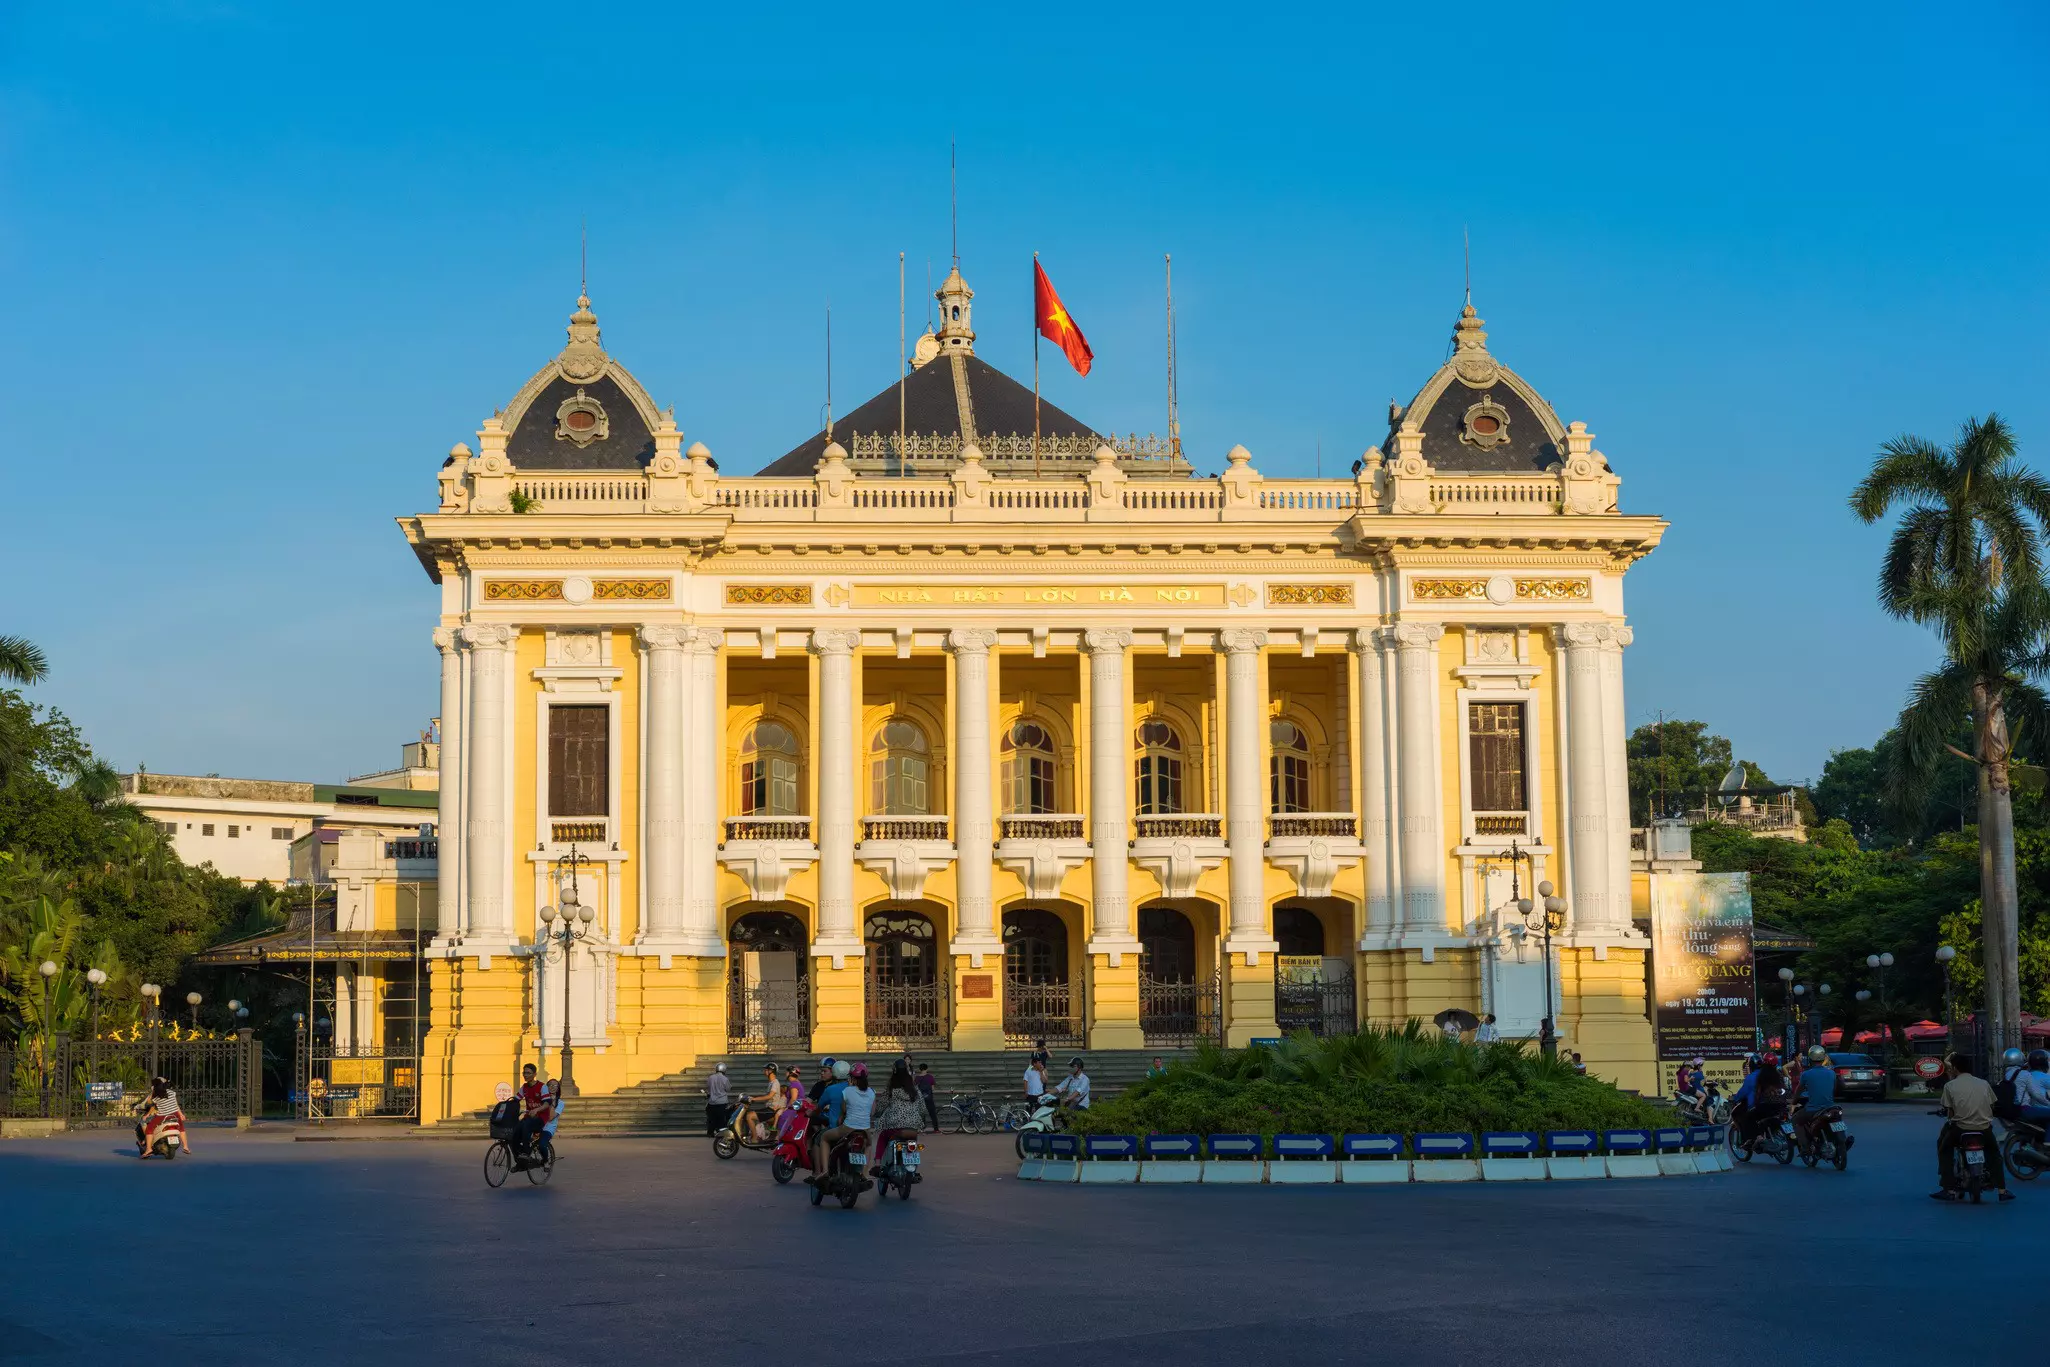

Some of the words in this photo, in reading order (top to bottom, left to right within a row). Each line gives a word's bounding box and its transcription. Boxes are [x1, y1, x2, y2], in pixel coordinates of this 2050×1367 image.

[879, 585, 933, 603] NHÀ
[1098, 585, 1134, 602] HÀ
[1156, 586, 1201, 605] NỘI
[1696, 965, 1751, 980] QUANG
[1682, 998, 1694, 1007] 19,
[1695, 998, 1708, 1007] 20,
[1709, 997, 1748, 1007] 21/9/2014
